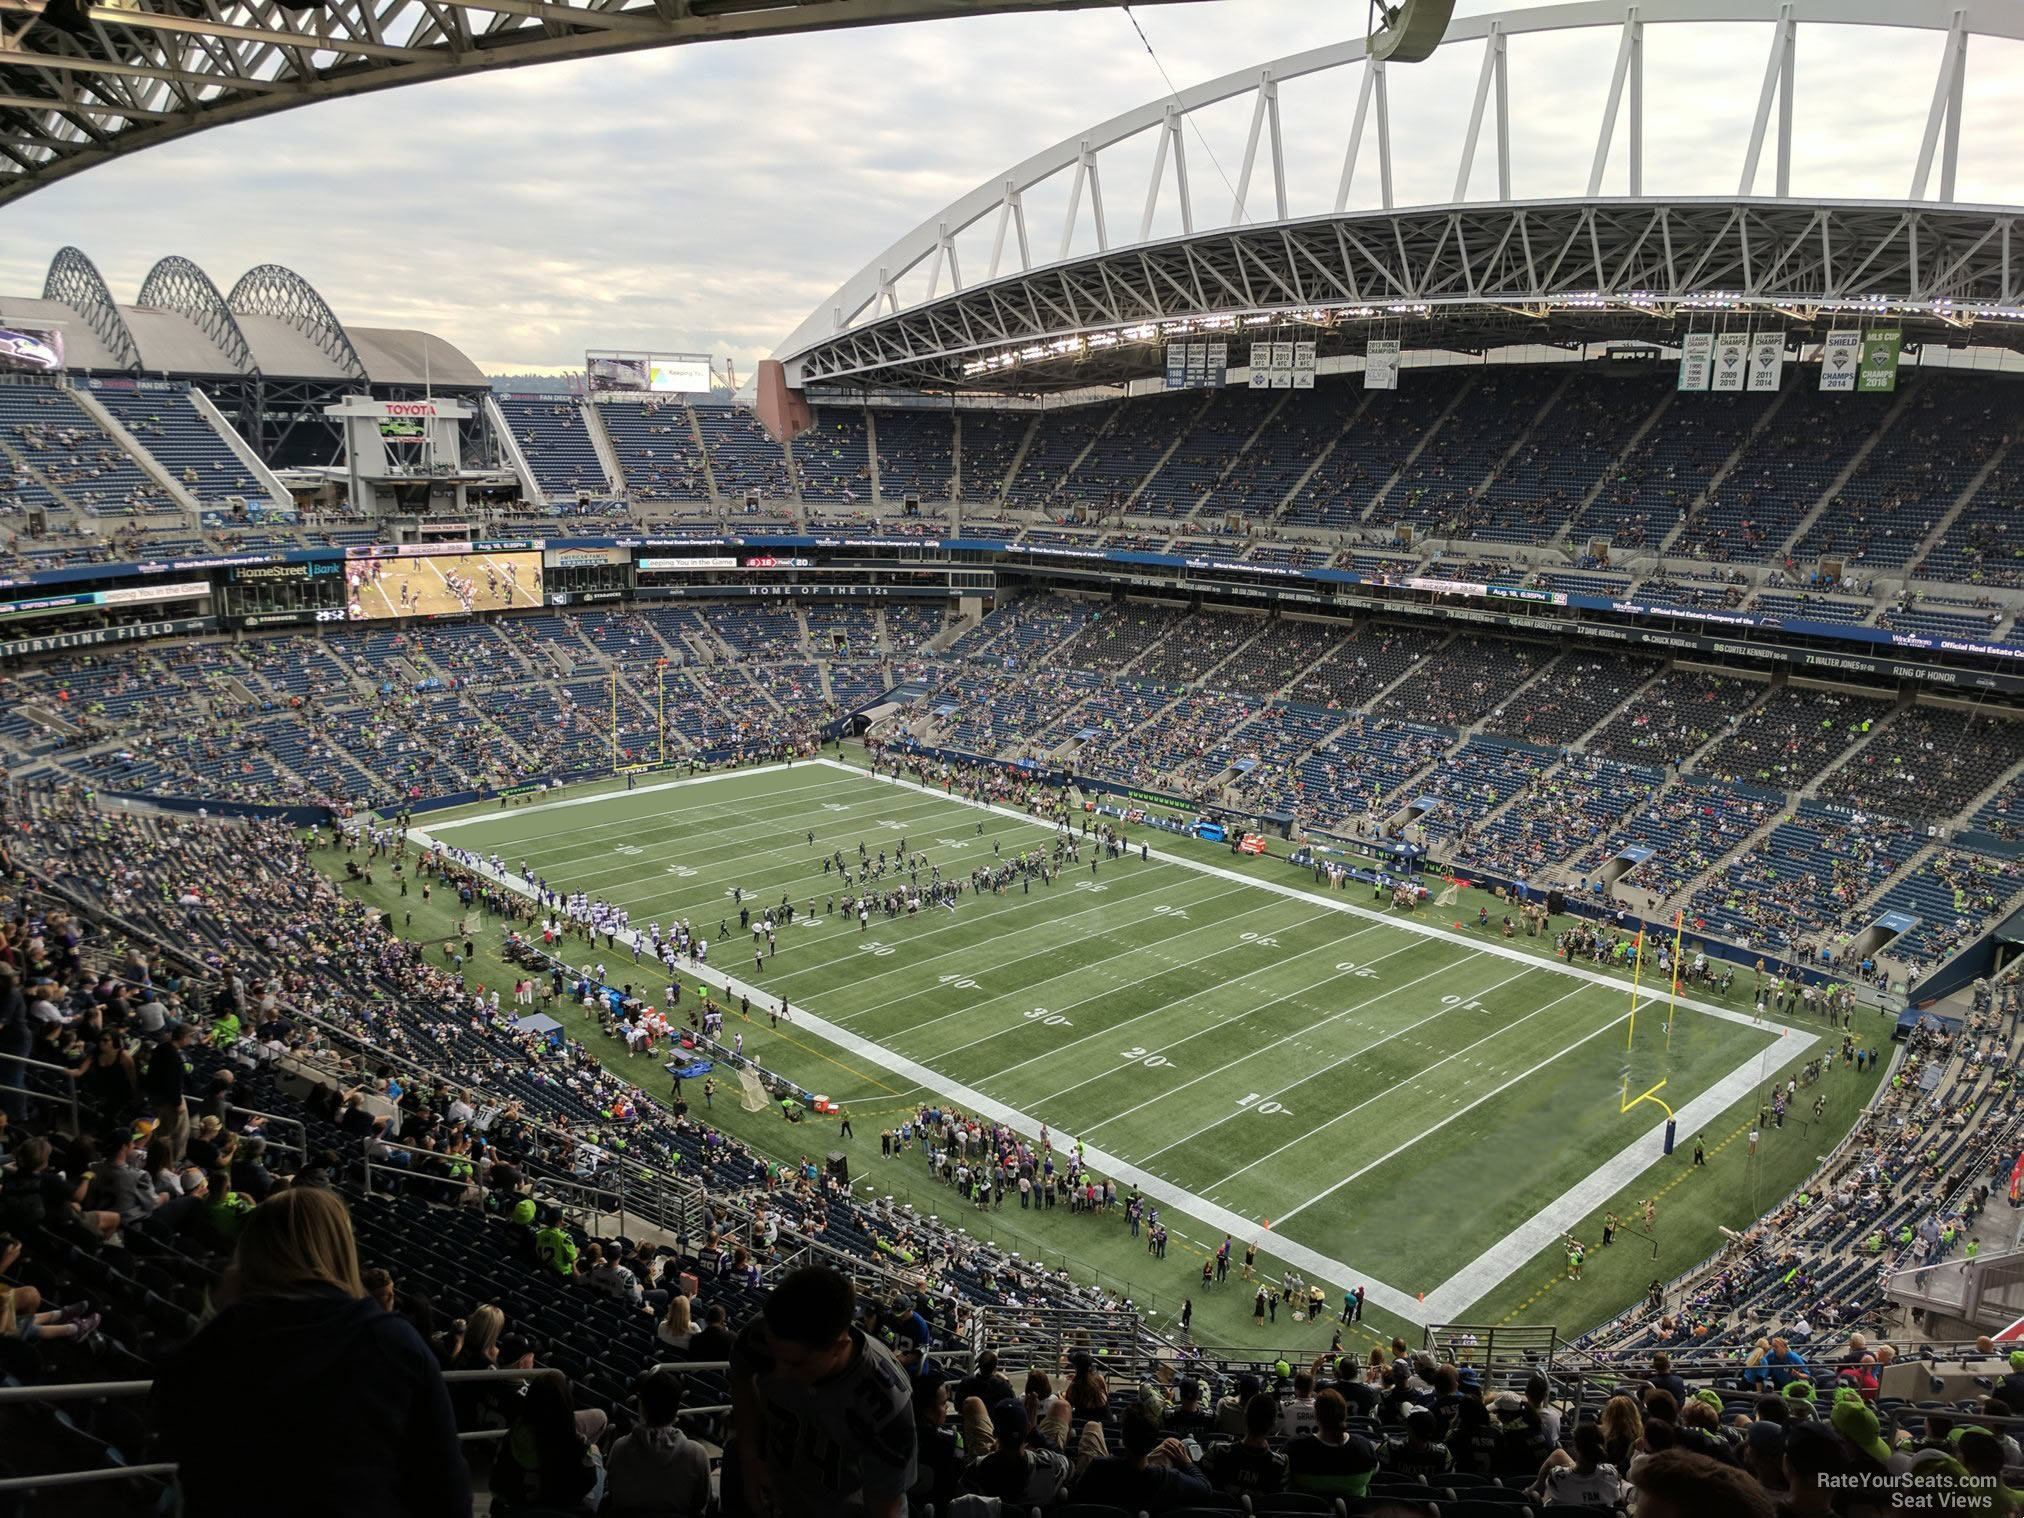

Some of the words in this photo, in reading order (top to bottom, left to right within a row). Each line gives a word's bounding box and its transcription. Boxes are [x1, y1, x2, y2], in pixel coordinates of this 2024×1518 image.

[386, 404, 437, 415] TOYOTA
[712, 558, 733, 566] Game
[236, 564, 307, 578] HomeStreet
[314, 563, 340, 574] Bank
[138, 588, 154, 597] You
[181, 583, 206, 592] Game
[750, 587, 791, 595] HOME
[829, 587, 857, 595] THE
[1493, 588, 1511, 598] Aug.
[1512, 590, 1520, 599] 18,
[316, 610, 345, 622] 29:52
[1469, 612, 1484, 620] GREEN
[1686, 611, 1706, 619] Estate
[1707, 613, 1735, 624] Company
[117, 623, 174, 639] FIELD
[1585, 627, 1597, 635] DAVE
[1598, 629, 1615, 638] KRIEG
[1651, 636, 1669, 646] CHUCK
[1670, 638, 1685, 647] KNOX
[1892, 634, 1932, 646] Windermere
[1714, 643, 1724, 652] 96
[1725, 645, 1746, 655] CORTEZ
[1747, 648, 1774, 659] KENNEDY
[1941, 641, 1967, 650] Official
[1968, 644, 1986, 653] Real
[1987, 646, 2013, 656] Estate
[1806, 655, 1815, 664] 71
[1815, 656, 1839, 667] WALTER
[1840, 660, 1860, 671] JONES
[1893, 666, 1914, 677] RING
[1915, 670, 1926, 679] OF
[1927, 671, 1956, 682] HONOR
[1075, 880, 1109, 891] 50
[1239, 932, 1276, 947] 30
[858, 942, 896, 956] 50
[1335, 962, 1375, 978] 20
[938, 973, 977, 989] 40
[1440, 995, 1482, 1011] 10
[1023, 1007, 1067, 1026] 30
[1120, 1046, 1168, 1068] 20
[1235, 1093, 1283, 1115] 10
[579, 1151, 593, 1164] 25
[1239, 1469, 1258, 1481] FAN
[1583, 1492, 1600, 1502] FAN
